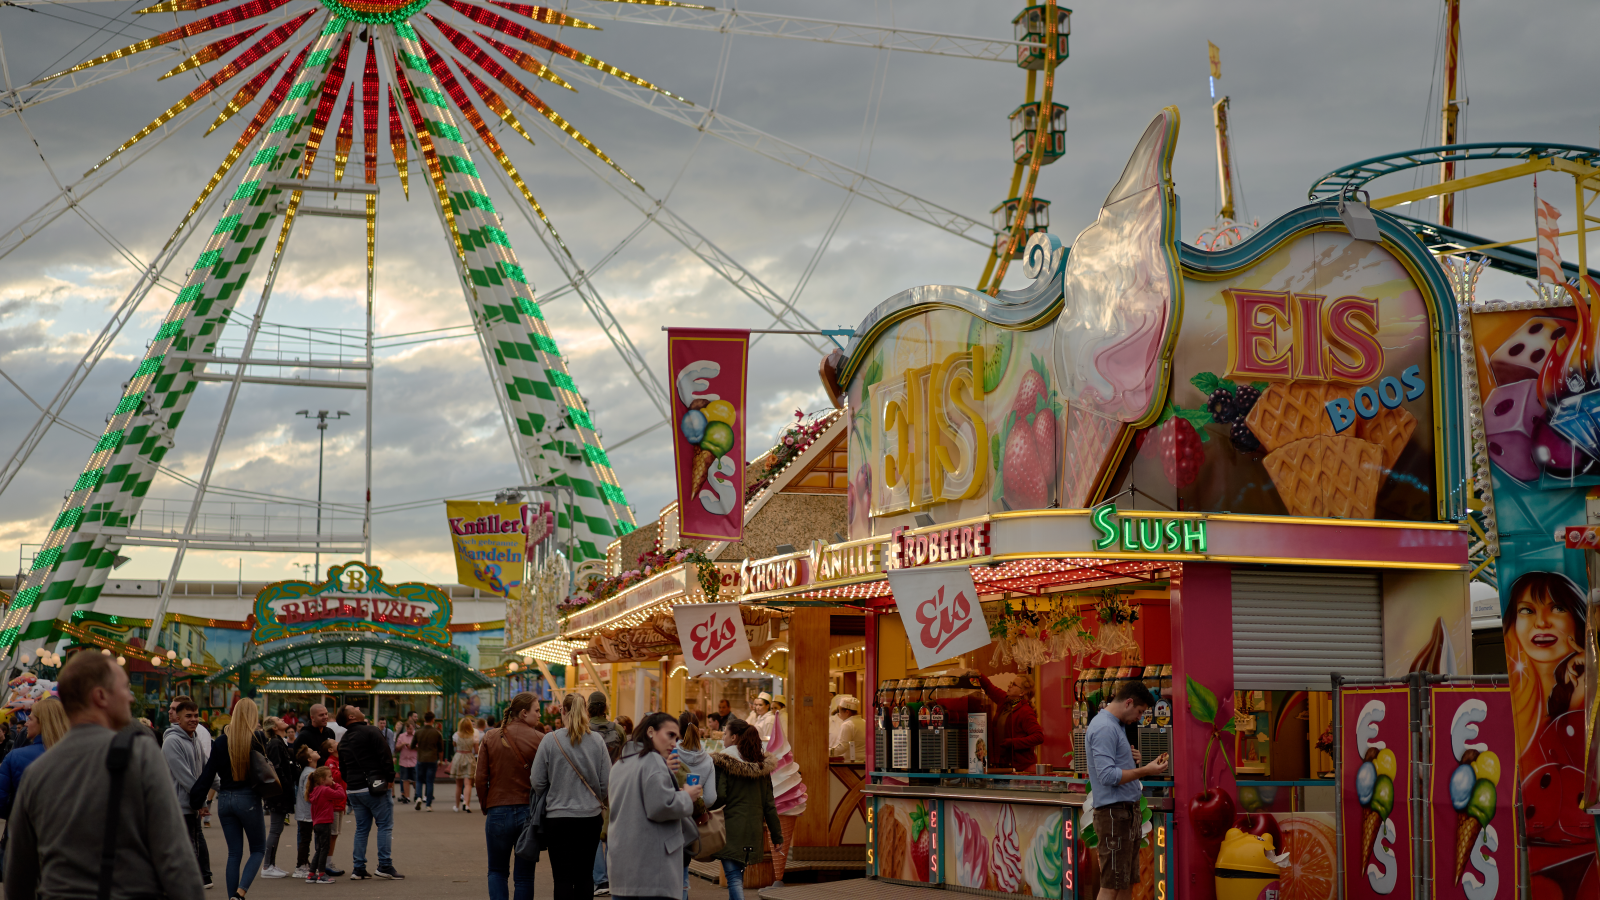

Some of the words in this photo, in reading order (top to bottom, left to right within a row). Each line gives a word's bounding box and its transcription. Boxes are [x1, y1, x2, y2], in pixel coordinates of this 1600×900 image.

[1221, 287, 1386, 385] EIS
[1324, 364, 1426, 434] BOOS
[868, 345, 988, 517] EIS
[449, 504, 529, 536] Knüller!
[478, 539, 519, 547] gebrannte
[1091, 503, 1208, 553] SLUSH
[456, 542, 522, 563] Mandeln
[889, 523, 991, 569] ERDBEERE
[347, 570, 365, 591] B
[282, 593, 424, 626] BELLEVUE
[915, 583, 972, 651] Eis
[689, 611, 737, 663] Eis
[311, 664, 377, 677] METROPOLITN
